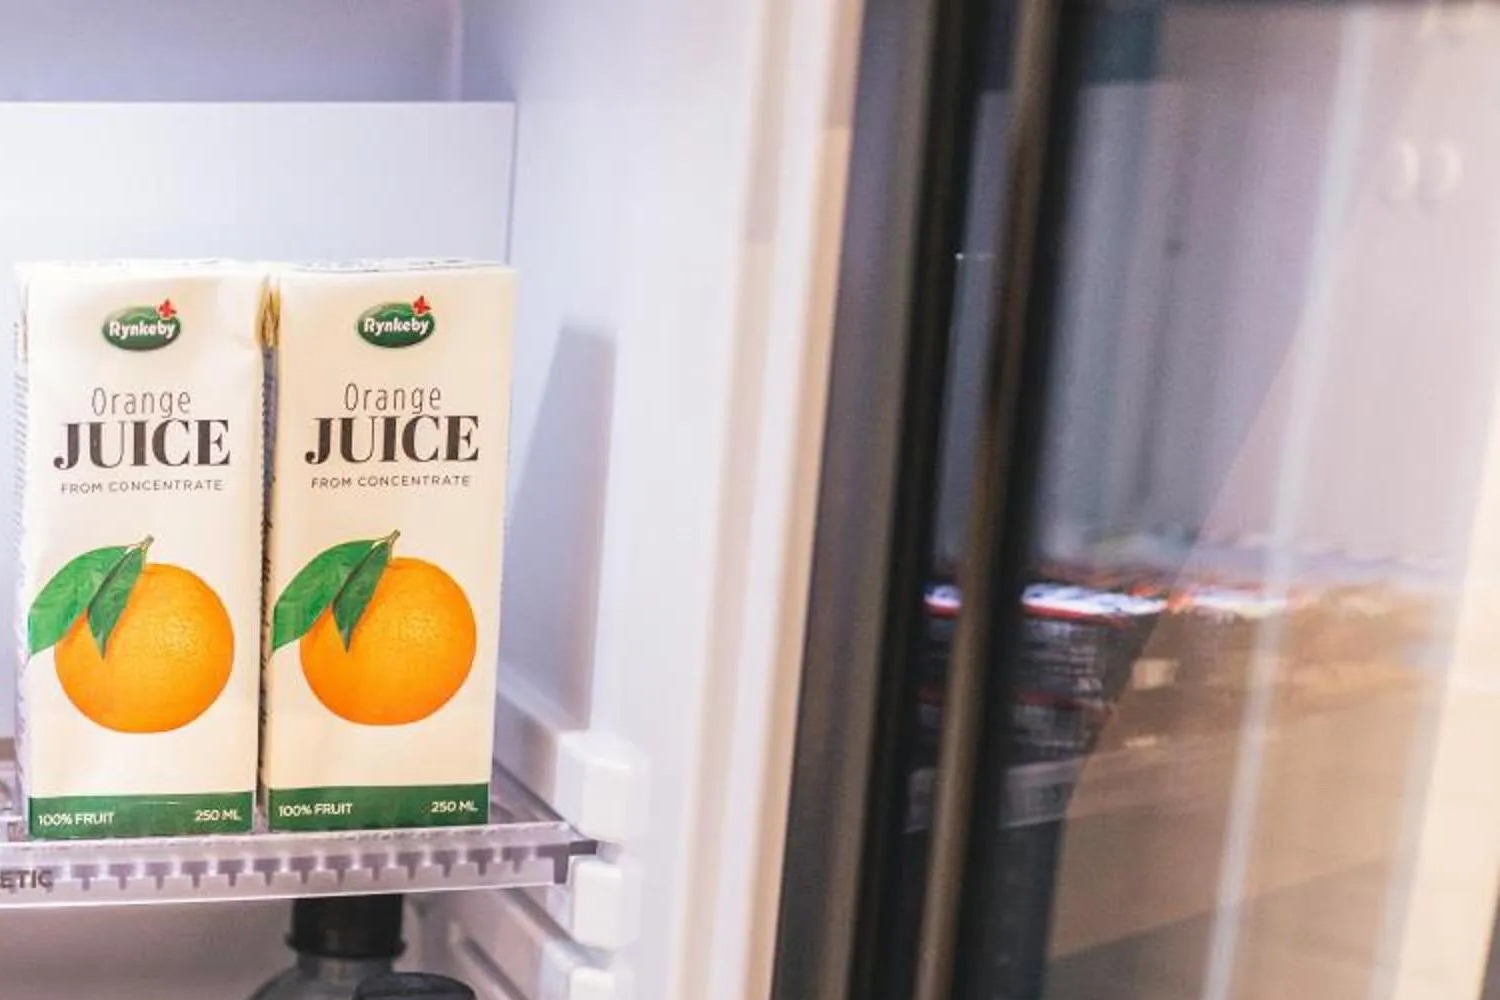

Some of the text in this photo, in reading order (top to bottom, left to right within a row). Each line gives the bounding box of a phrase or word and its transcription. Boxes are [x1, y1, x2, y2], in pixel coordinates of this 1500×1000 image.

[109, 319, 175, 340] Rynkeby
[364, 317, 429, 336] Rynkeby
[92, 387, 191, 418] Orange
[344, 382, 441, 415] Orange
[53, 418, 231, 470] JUICE
[304, 414, 479, 465] JUICE
[60, 479, 223, 494] FROM CONCENTRATE
[311, 474, 471, 489] FROM CONCENTRATE
[194, 809, 242, 822] 250 ML
[279, 802, 353, 817] 100% FRUIT
[431, 800, 478, 814] 250 ML
[38, 811, 114, 826] 100% FRUIT
